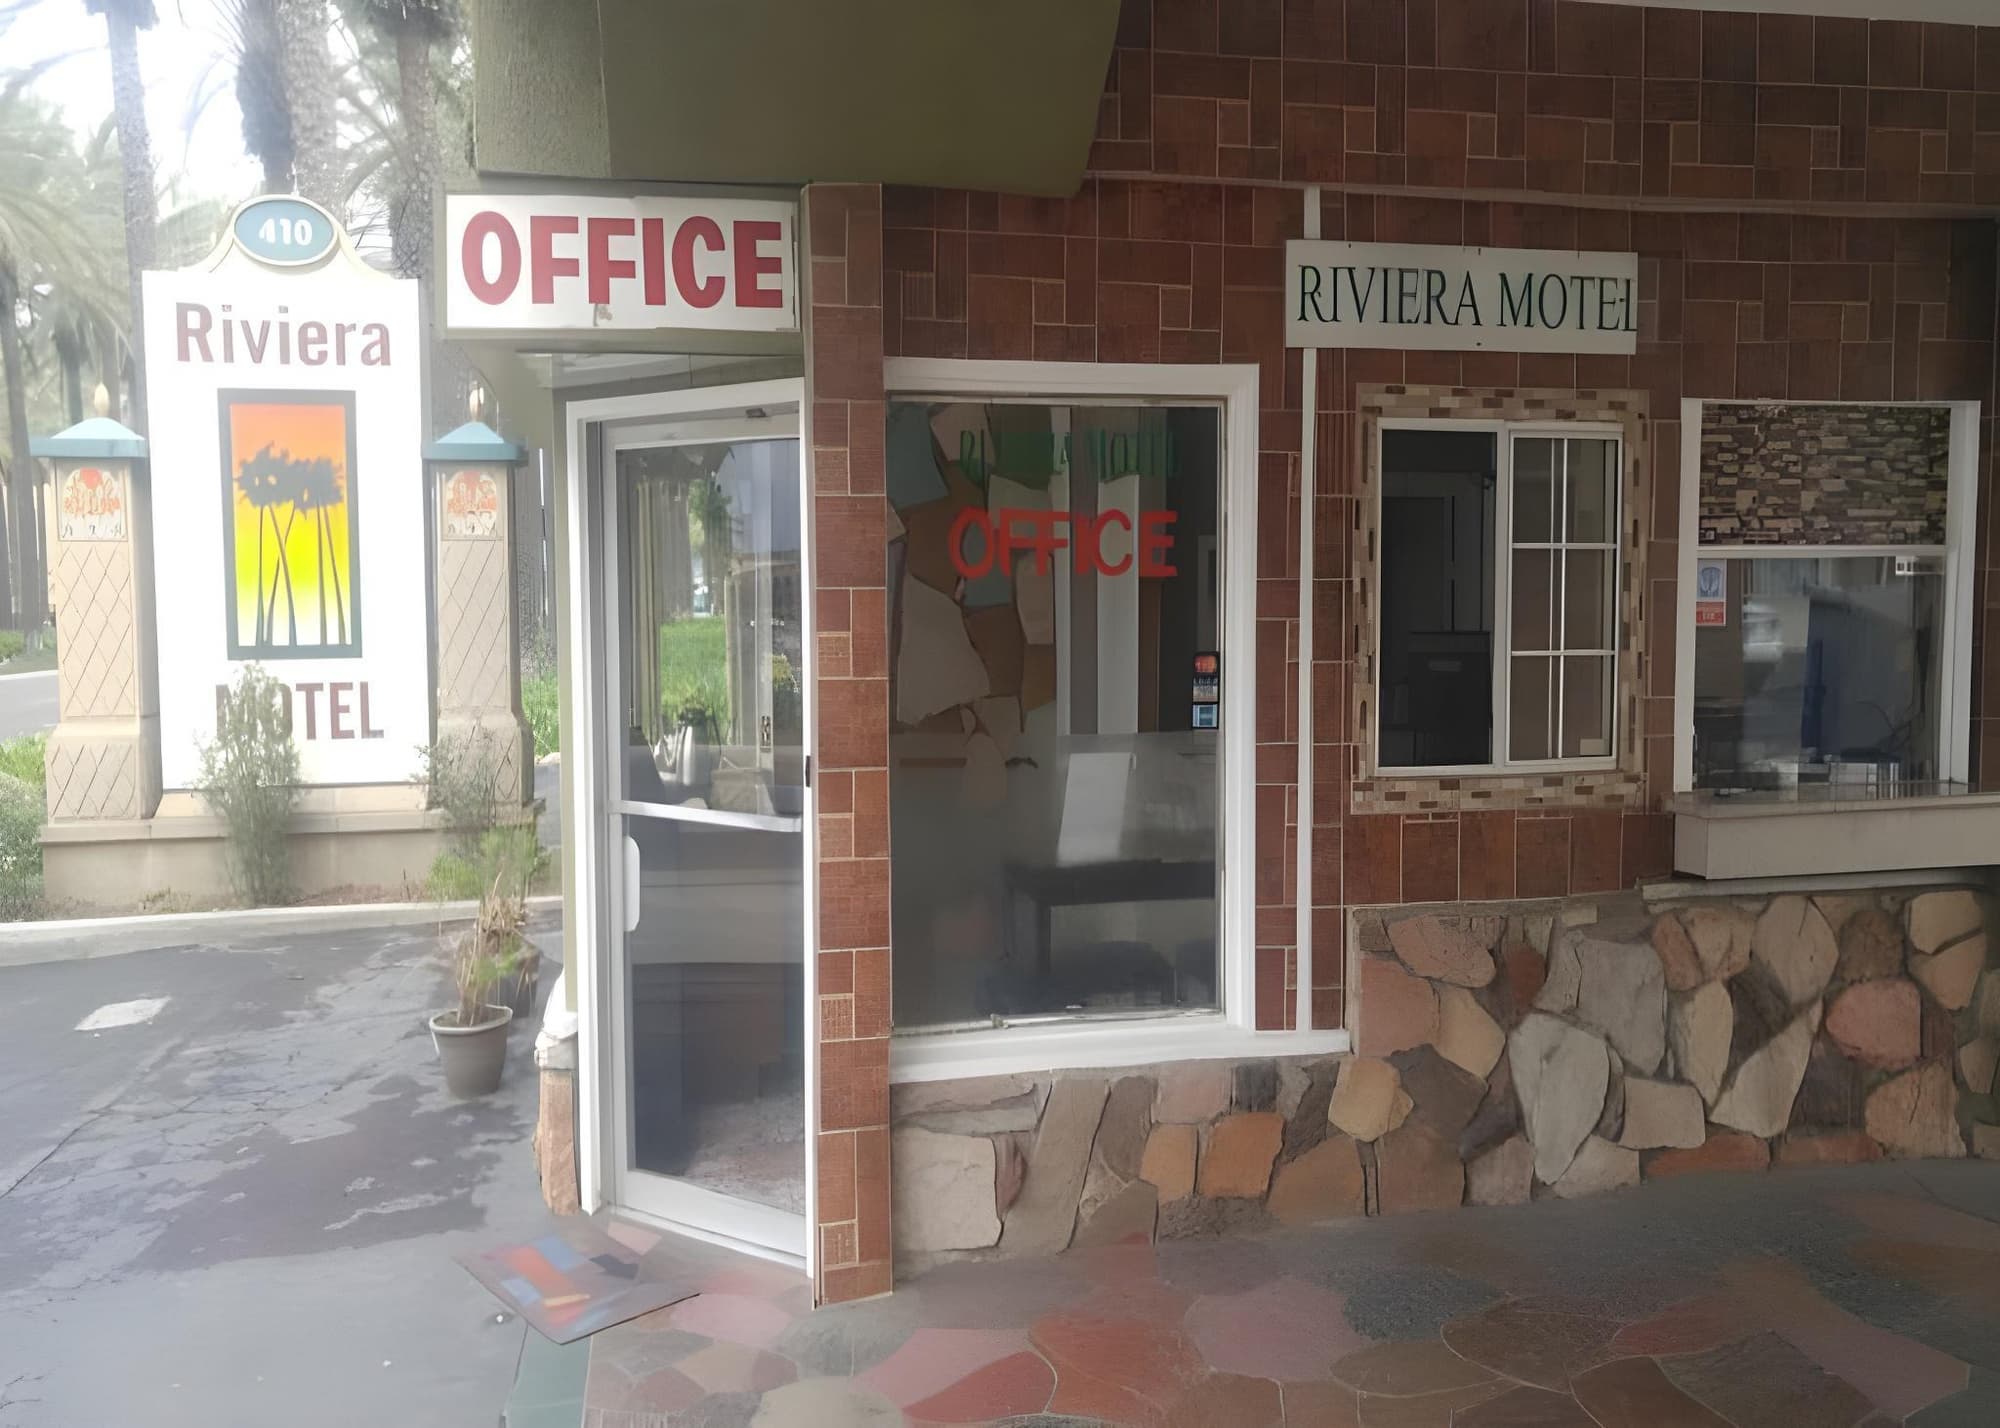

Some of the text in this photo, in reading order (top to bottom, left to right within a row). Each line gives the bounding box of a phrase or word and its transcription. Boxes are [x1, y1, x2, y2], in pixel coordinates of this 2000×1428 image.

[258, 218, 313, 246] 410
[461, 210, 783, 309] OFFICE
[1296, 264, 1483, 327] RIVIERA
[175, 301, 392, 367] Riviera
[947, 504, 1178, 579] OFFICE
